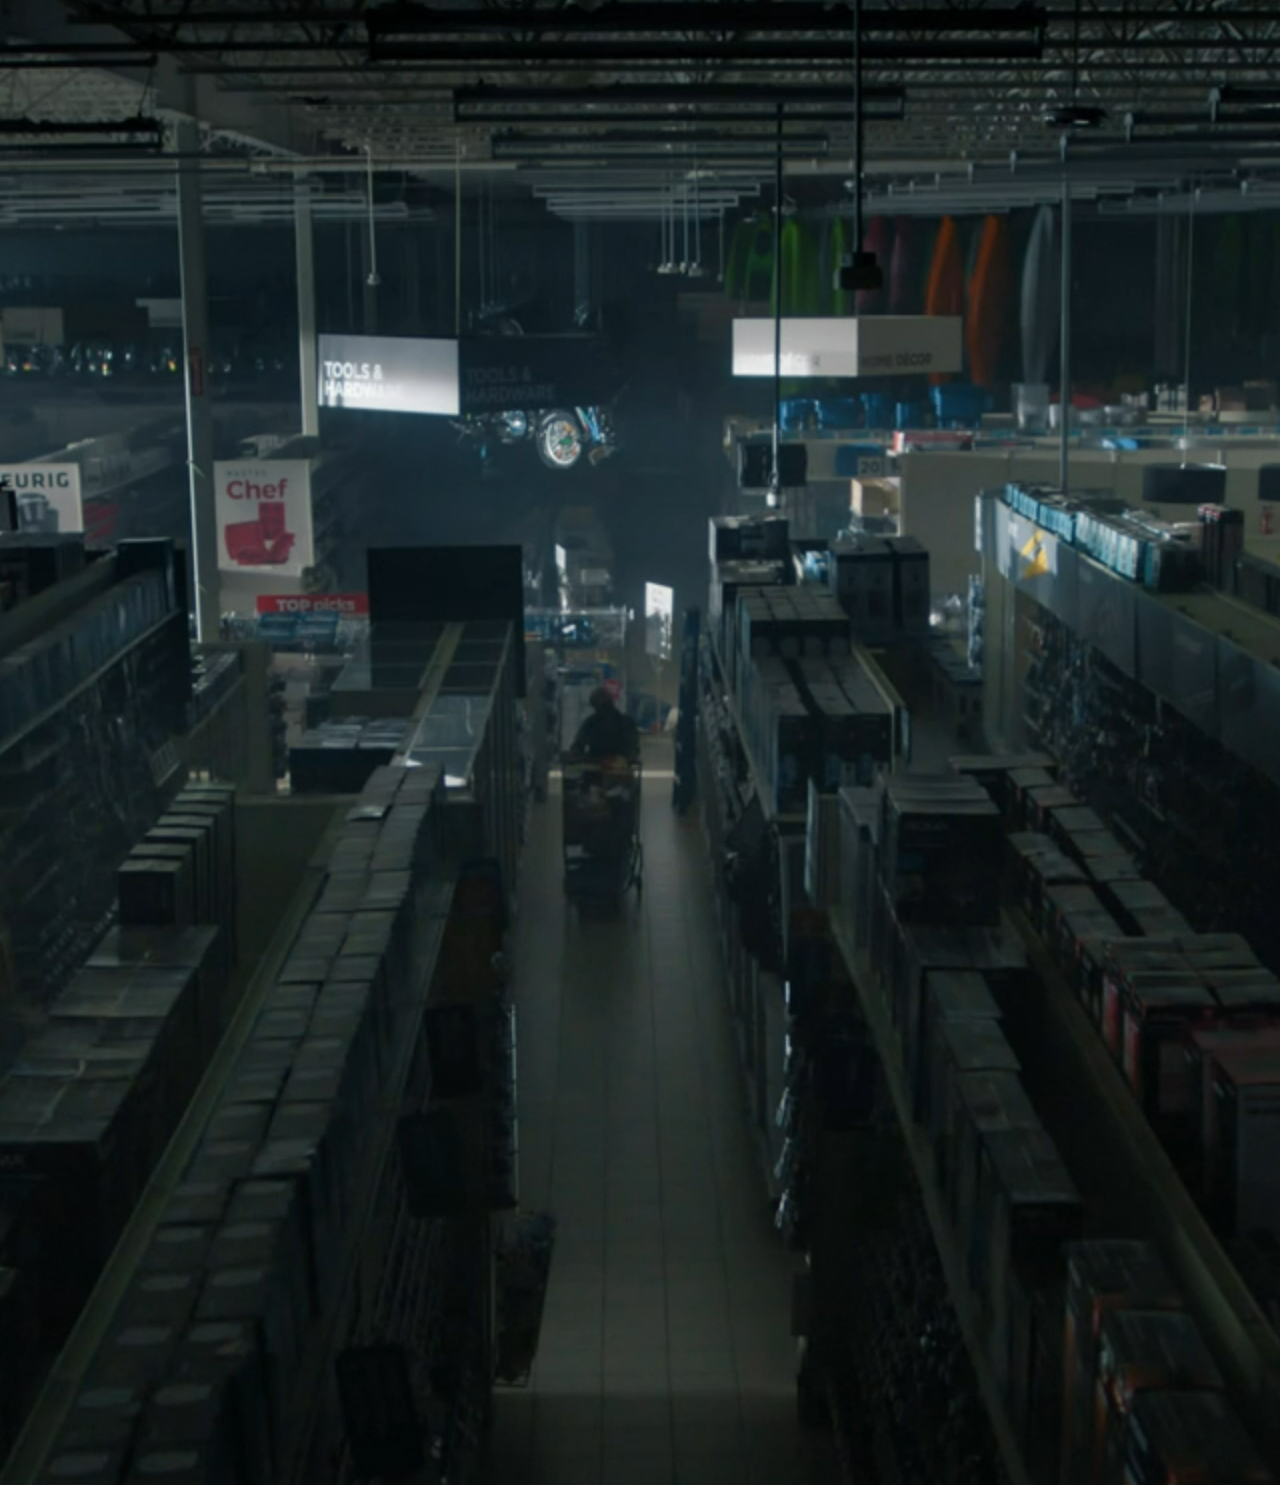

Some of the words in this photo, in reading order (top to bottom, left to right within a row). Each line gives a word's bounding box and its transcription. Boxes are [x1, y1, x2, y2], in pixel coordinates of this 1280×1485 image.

[324, 362, 370, 381] TOOLS
[372, 367, 383, 381] &
[465, 369, 517, 385] TOOLS
[324, 380, 402, 399] HARDWA
[465, 384, 555, 403] HARDWARE
[226, 478, 288, 500] Chef
[276, 598, 310, 612] TOP
[313, 599, 356, 615] picks
